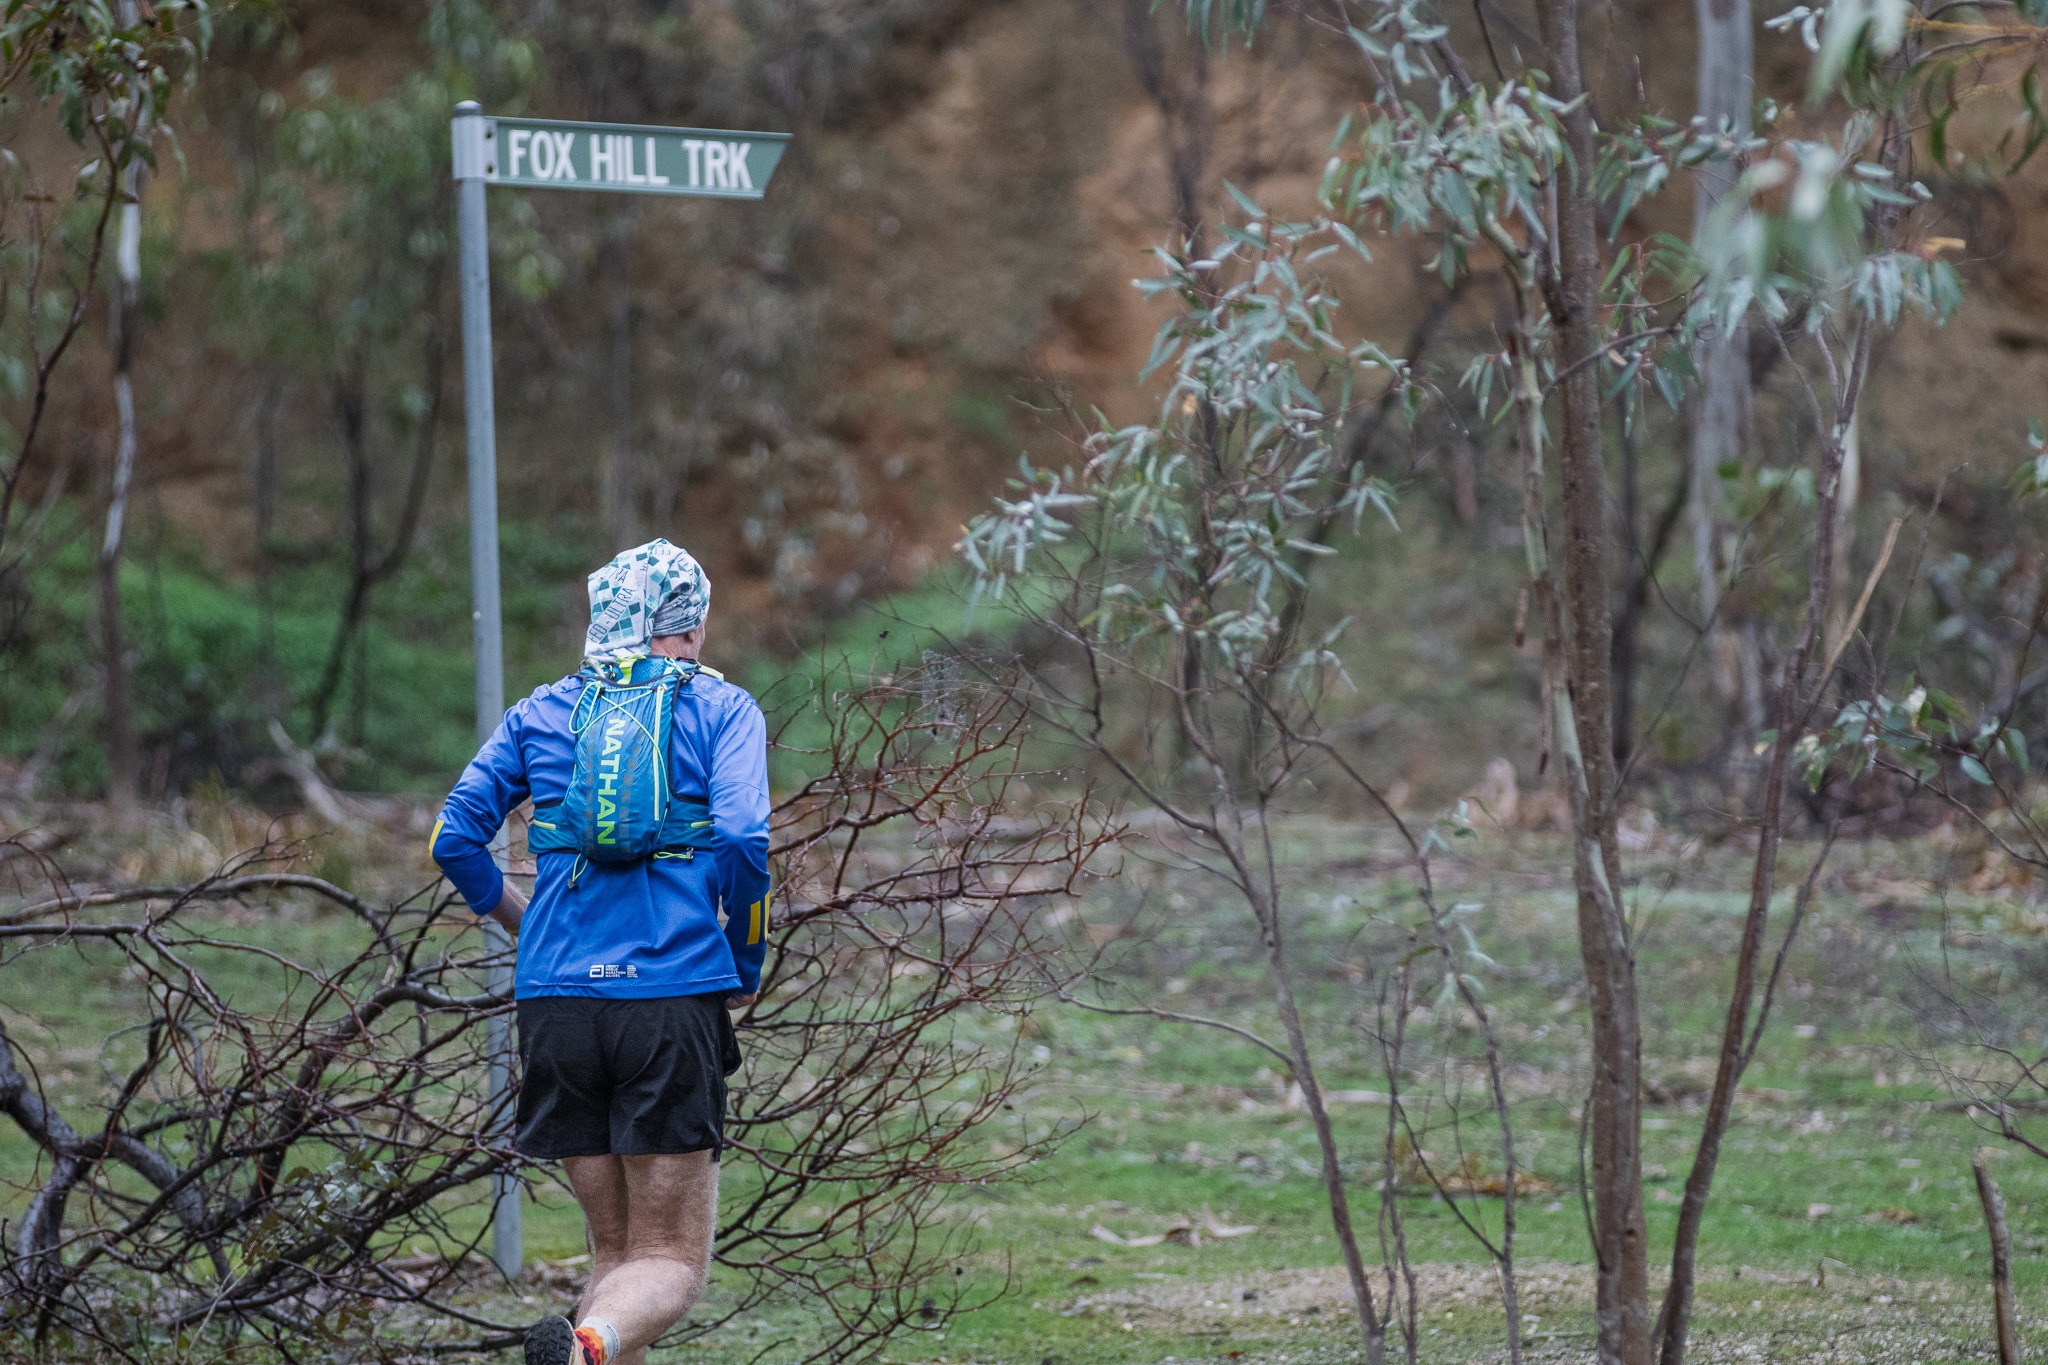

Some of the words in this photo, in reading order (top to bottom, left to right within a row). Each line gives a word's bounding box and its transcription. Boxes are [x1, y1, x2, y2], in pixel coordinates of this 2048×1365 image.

[508, 129, 577, 180] FOX
[590, 133, 670, 184] HILL
[682, 139, 753, 189] TRK
[597, 718, 627, 844] NATHAN
